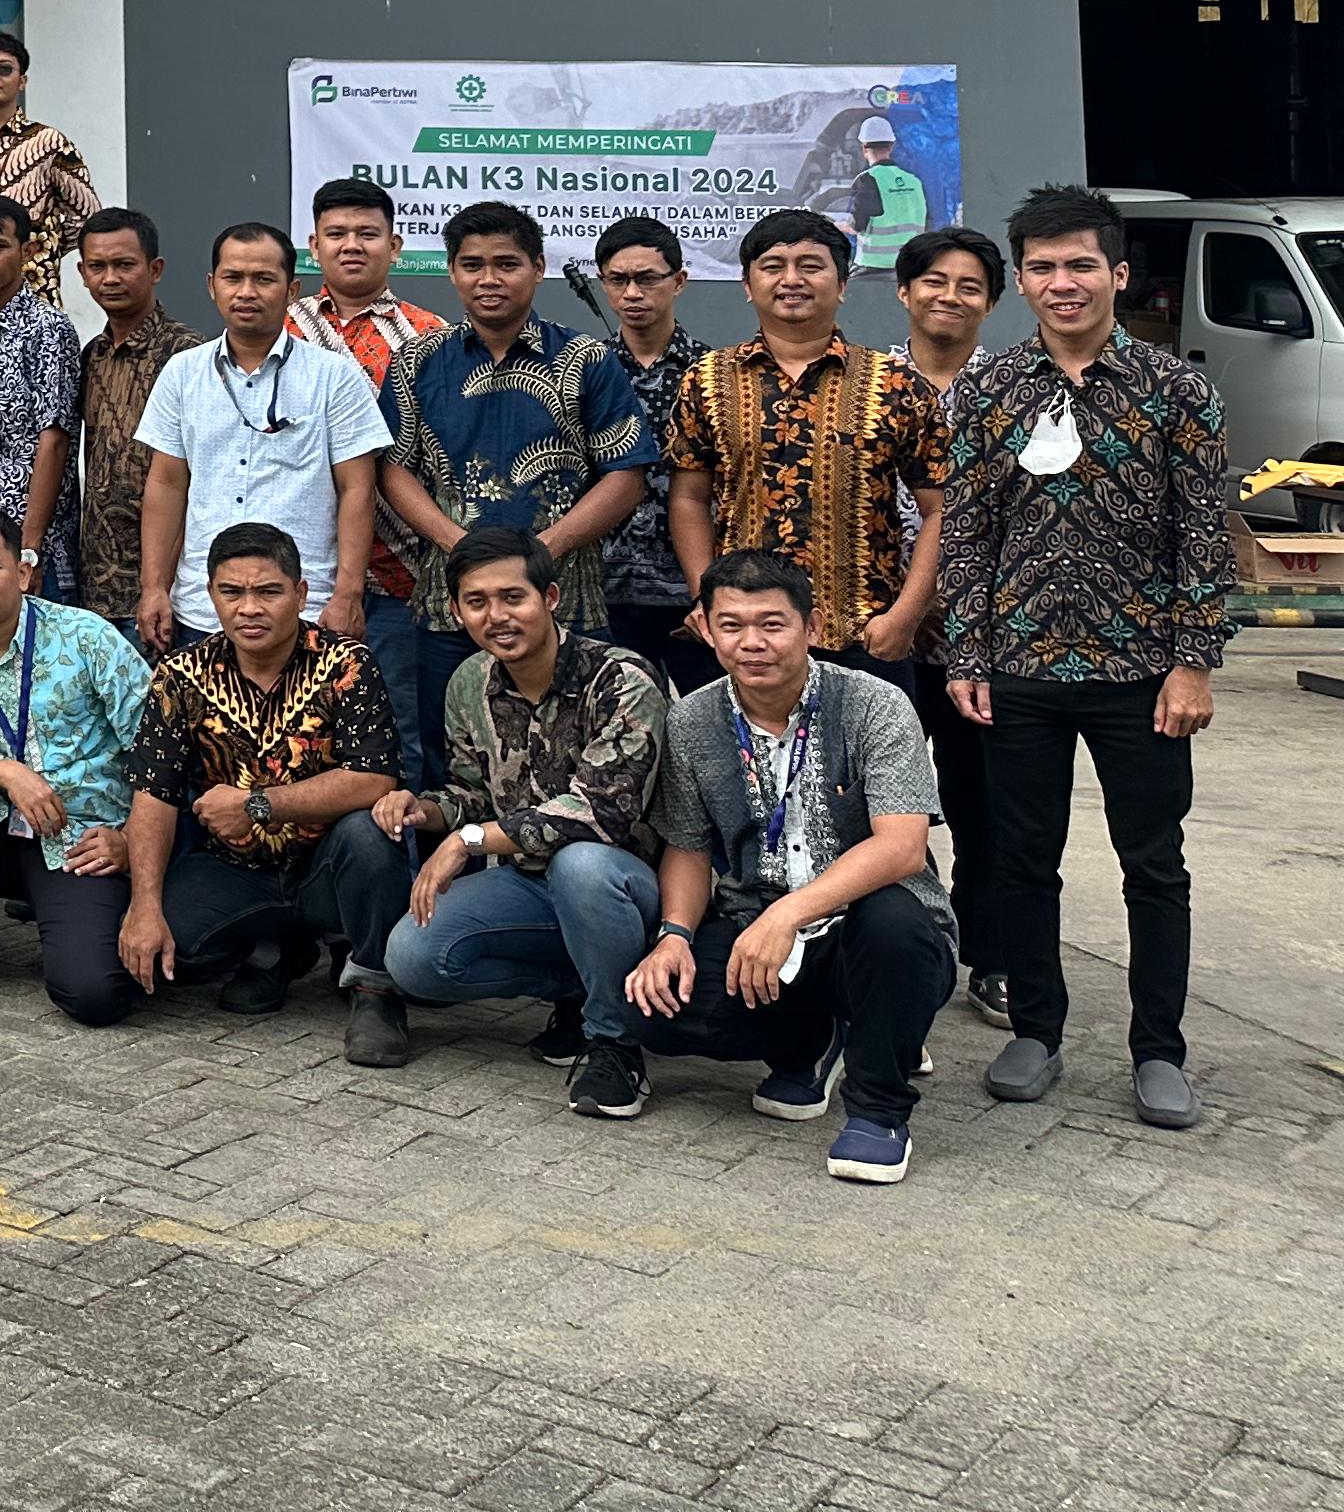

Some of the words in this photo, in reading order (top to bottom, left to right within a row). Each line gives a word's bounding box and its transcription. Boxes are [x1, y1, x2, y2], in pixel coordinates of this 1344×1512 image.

[438, 133, 531, 149] SELAMAT
[537, 134, 692, 150] MEMPERINGATI
[352, 164, 468, 190] BULAN
[481, 166, 524, 191] K3
[537, 166, 679, 192] Nasional
[691, 168, 777, 194] 2024
[537, 205, 574, 218] DAN
[579, 205, 661, 220] SELAMAT
[668, 206, 729, 220] DALAM
